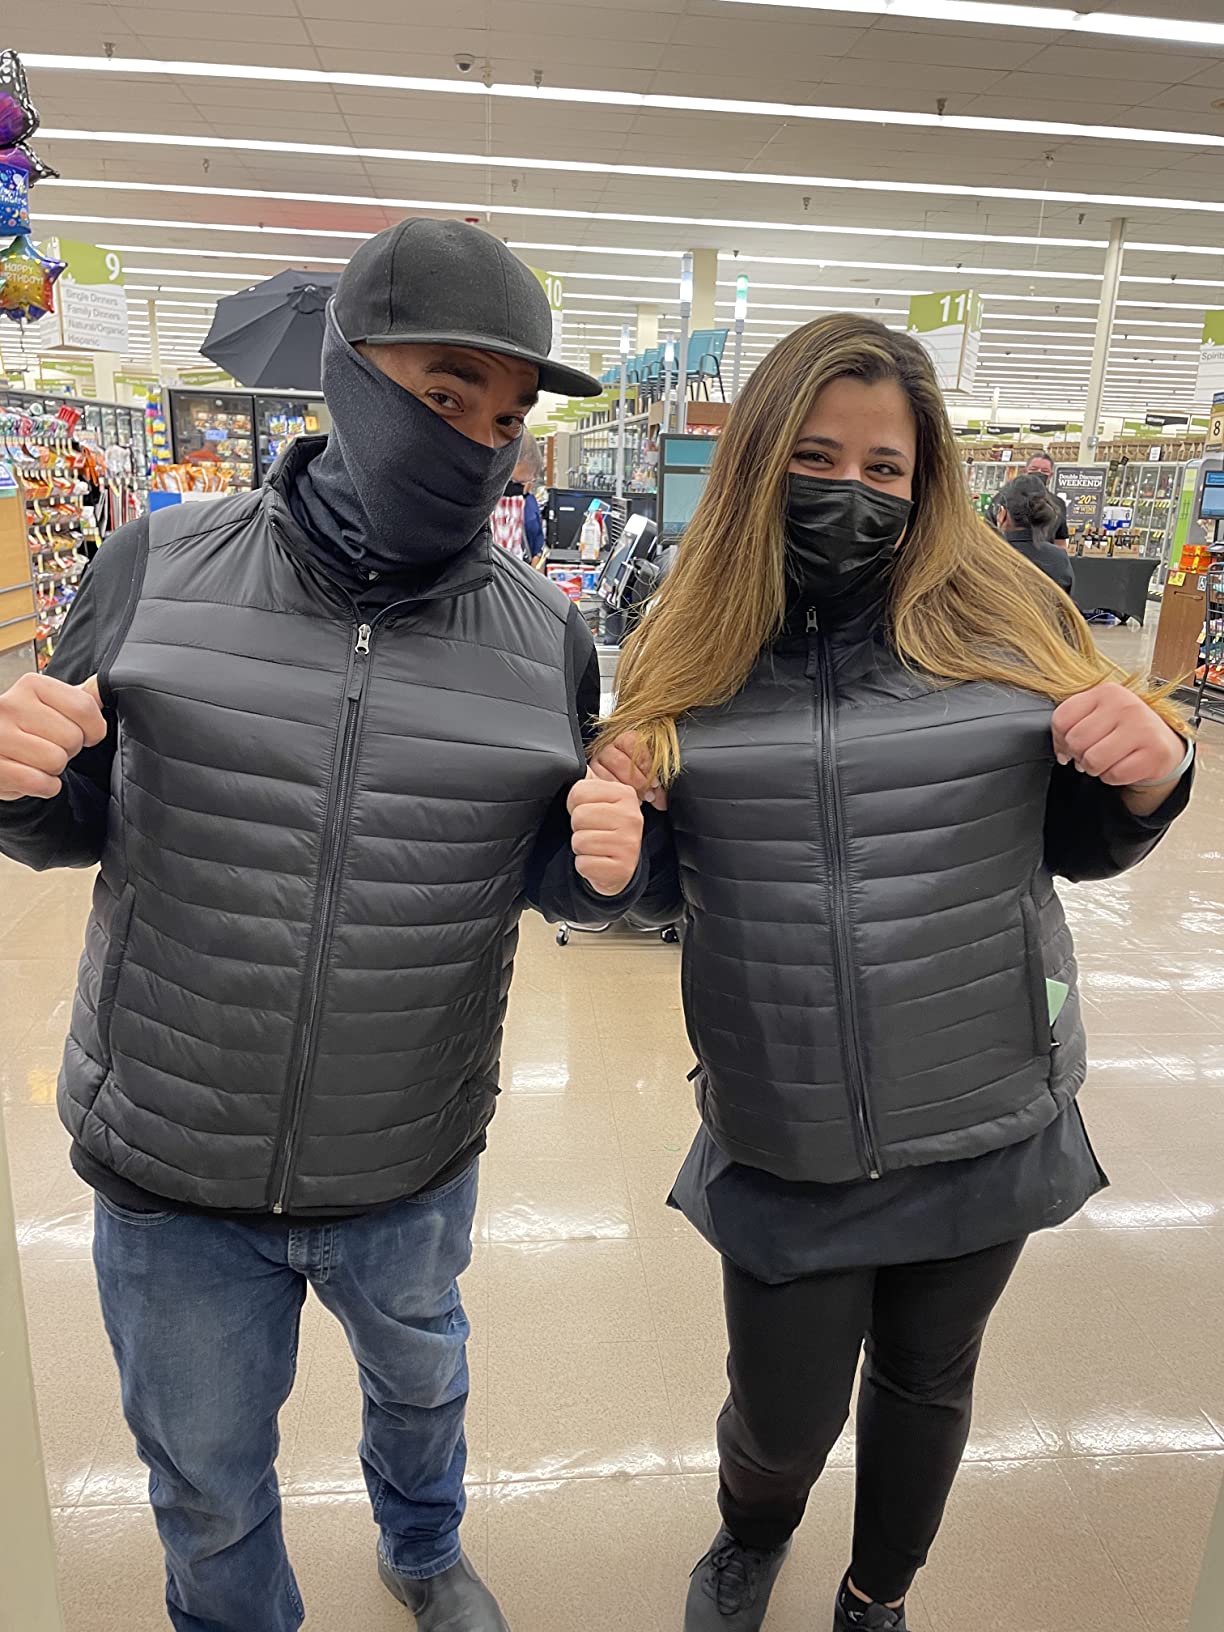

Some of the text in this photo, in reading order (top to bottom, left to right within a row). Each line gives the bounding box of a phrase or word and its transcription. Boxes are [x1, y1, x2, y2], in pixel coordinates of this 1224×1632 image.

[4, 262, 34, 275] HAPPY
[105, 253, 120, 280] 9
[66, 288, 118, 306] Single Dinners
[545, 277, 562, 307] 10
[67, 303, 121, 321] Family Dinners
[940, 293, 967, 322] 11
[1213, 420, 1221, 436] 8
[1058, 479, 1102, 488] WEEKEND!
